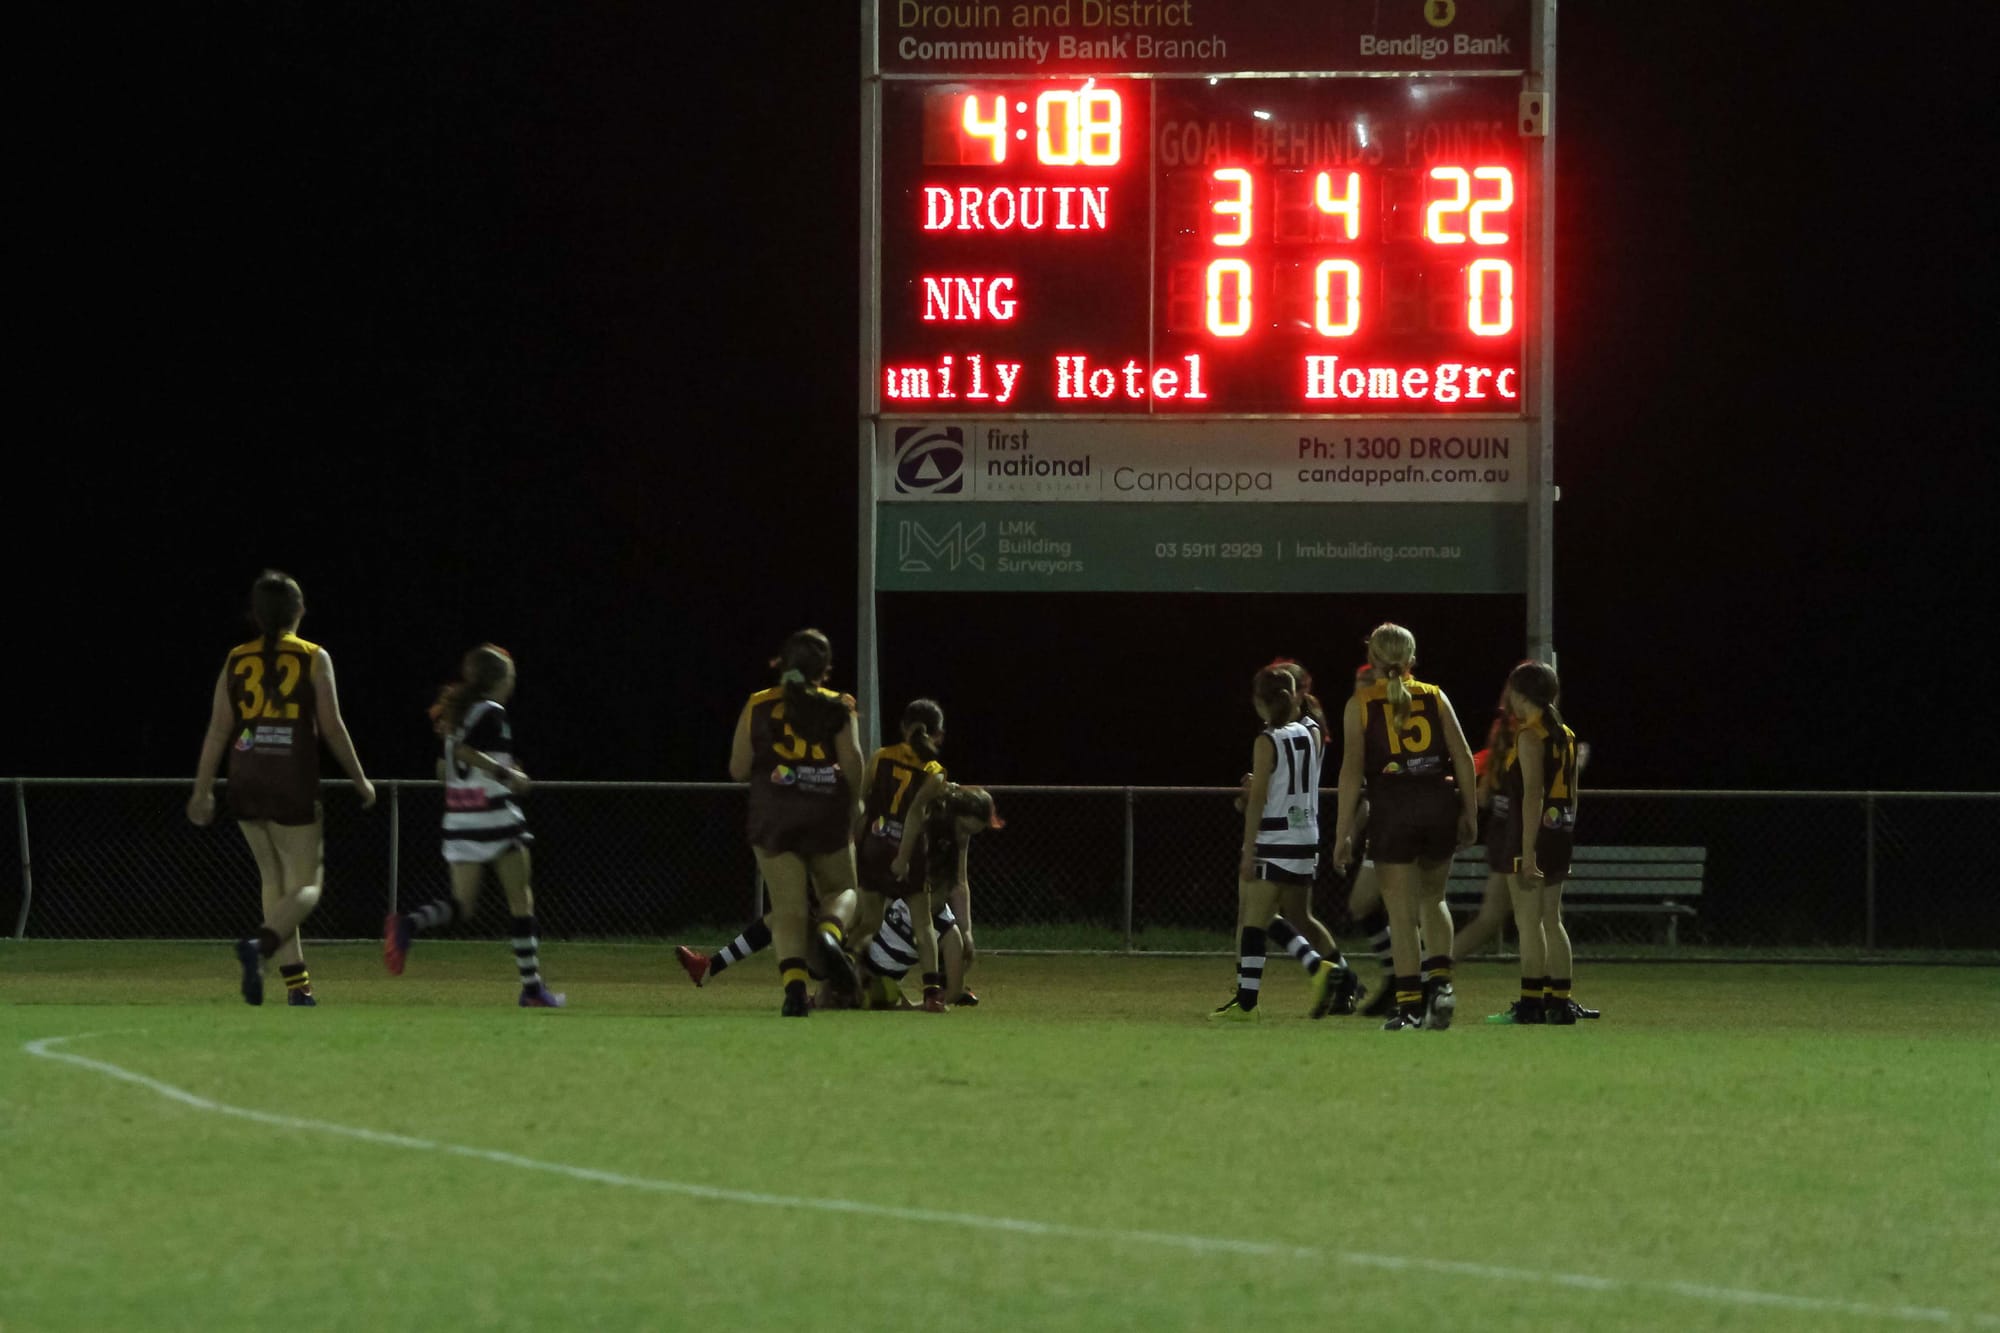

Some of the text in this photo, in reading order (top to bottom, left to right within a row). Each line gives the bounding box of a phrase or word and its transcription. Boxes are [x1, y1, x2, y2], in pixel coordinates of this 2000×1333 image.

[898, 0, 1193, 28] Drouin and District
[899, 36, 1050, 64] Community
[1136, 34, 1227, 58] Branch
[1360, 34, 1511, 60] Bendigo Bank
[963, 89, 1121, 166] 4:08
[1160, 120, 1503, 166] GOAL BEHINDS POINTS
[923, 166, 1514, 246] DROUIN 3 4 22
[923, 258, 1513, 337] NNG 0 0 0
[1056, 354, 1207, 398] Hotel
[987, 429, 1029, 450] first
[1299, 438, 1509, 459] Ph: 1300 DROUIN
[987, 454, 1090, 476] national
[1298, 465, 1509, 486] candappafn.com.au
[1113, 466, 1272, 496] Candappa
[999, 521, 1036, 536] LMK
[999, 539, 1071, 557] Building
[1155, 542, 1461, 562] 03 5911 2929 lmkbuilding.com.au
[998, 558, 1084, 574] Surveyors
[234, 655, 300, 719] 32
[1383, 699, 1432, 755] 15
[1283, 736, 1311, 795] 17
[890, 766, 912, 816] 7
